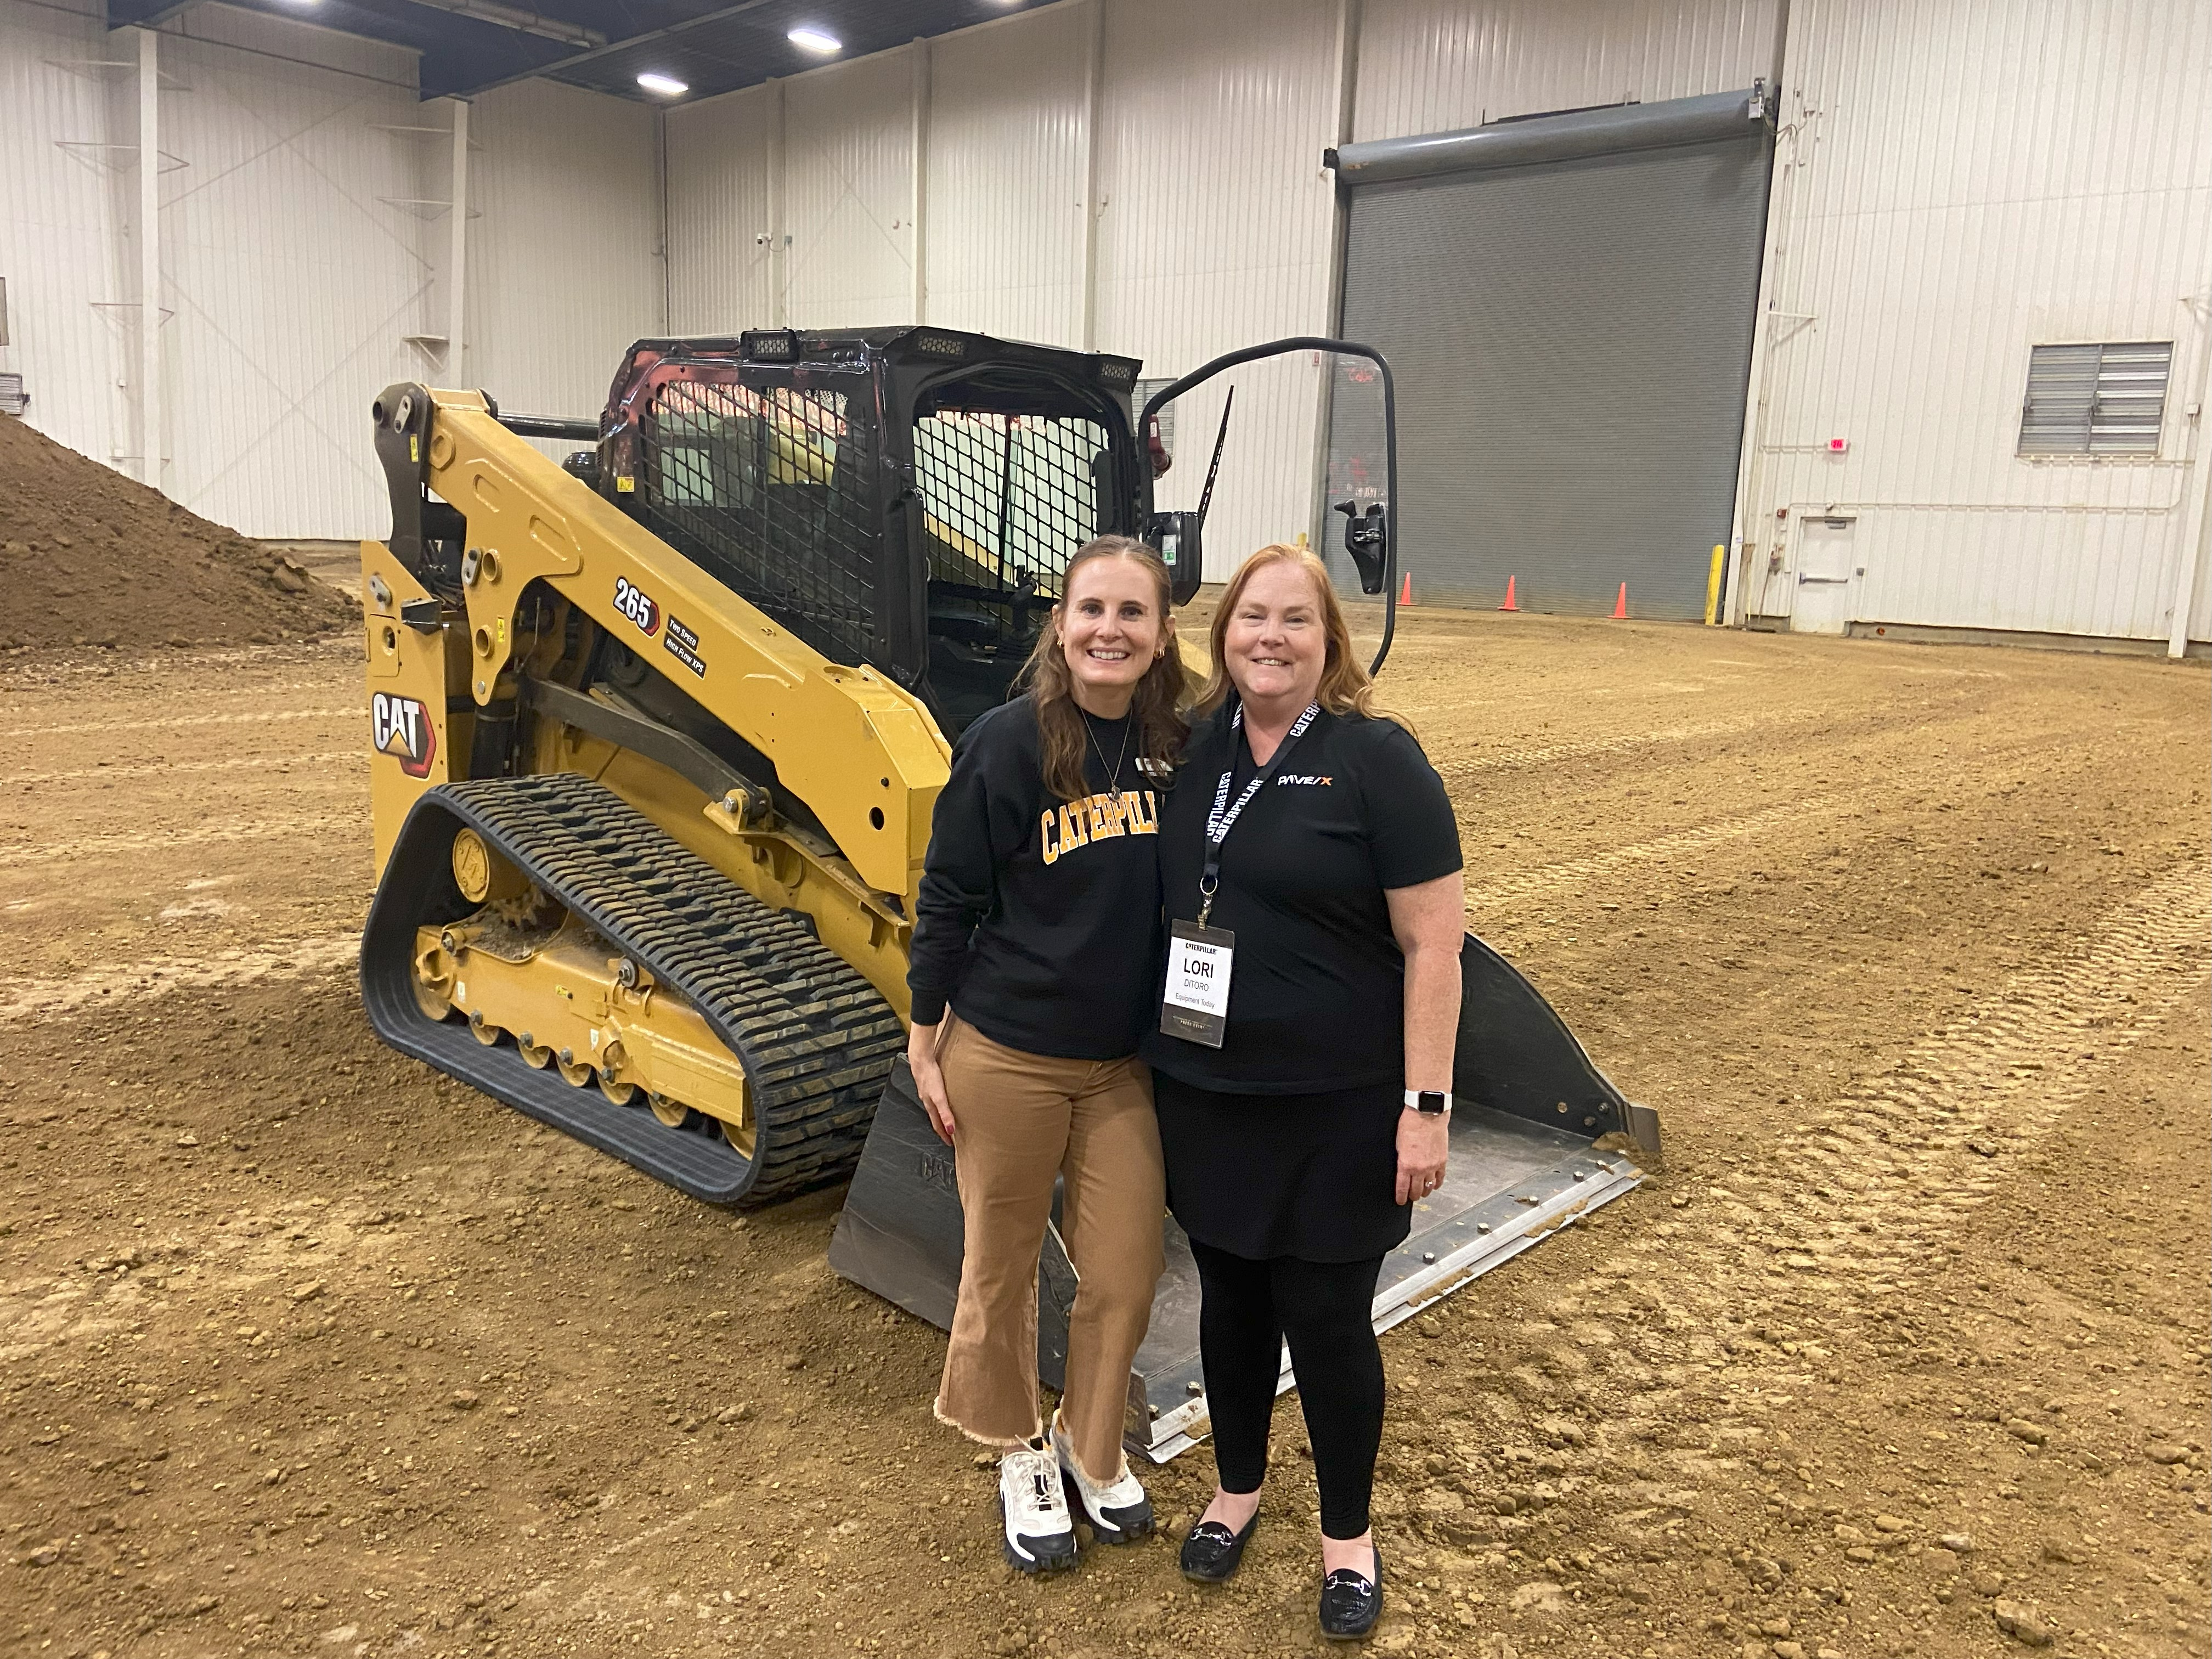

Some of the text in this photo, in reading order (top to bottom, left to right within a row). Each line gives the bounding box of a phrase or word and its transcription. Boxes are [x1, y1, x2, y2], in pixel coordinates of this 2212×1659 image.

[613, 578, 651, 628] 265
[692, 659, 704, 673] XPS
[373, 693, 420, 759] CAT
[1207, 771, 1232, 836] CATERPILLAR
[1212, 778, 1263, 843] CATERPILLAR
[1186, 943, 1217, 955] CATERPILLAR
[1184, 958, 1214, 978] LORI
[1184, 979, 1209, 991] DITORO
[1175, 992, 1215, 1009] Equipment Today
[922, 1152, 954, 1187] CAT
